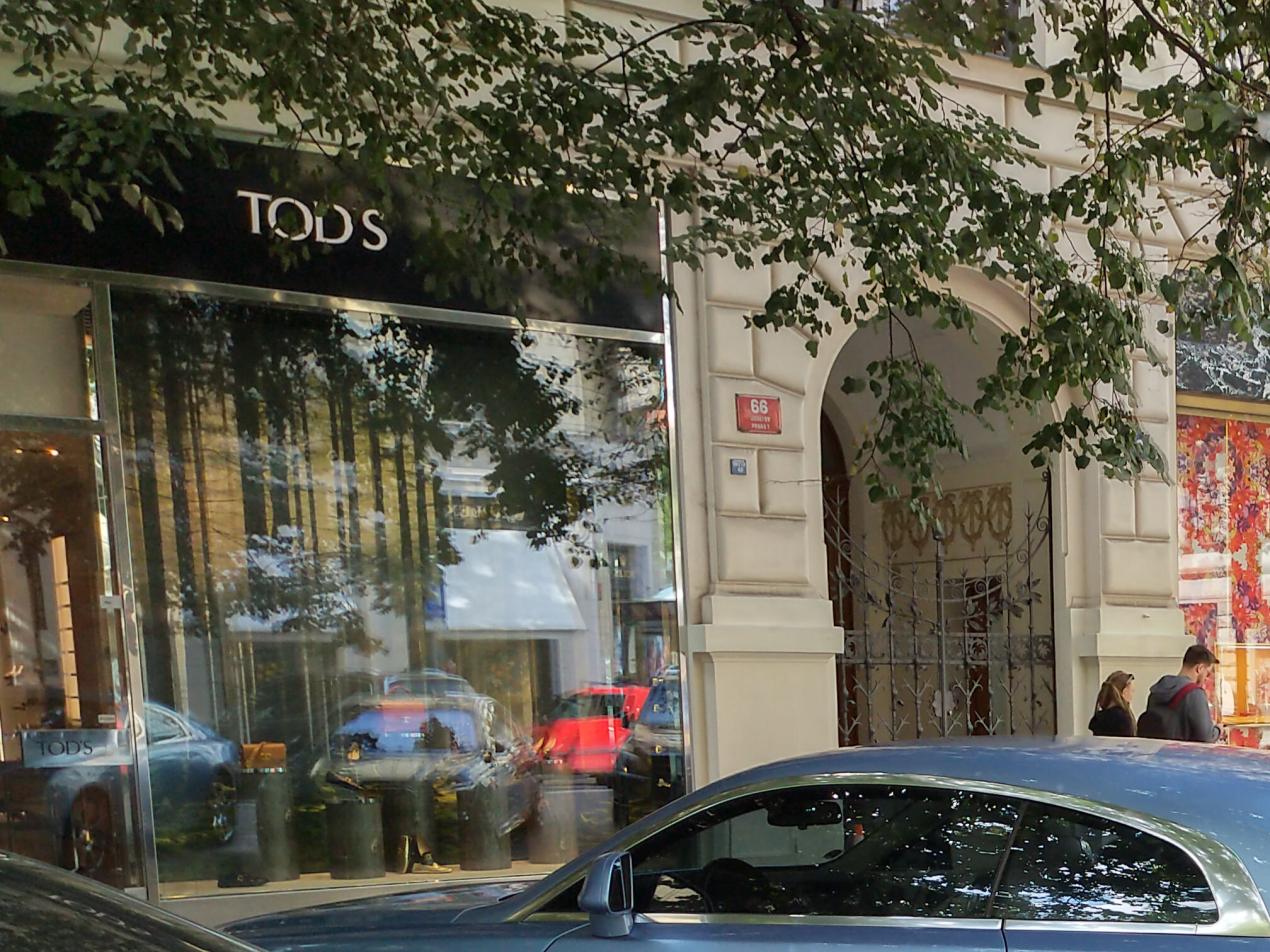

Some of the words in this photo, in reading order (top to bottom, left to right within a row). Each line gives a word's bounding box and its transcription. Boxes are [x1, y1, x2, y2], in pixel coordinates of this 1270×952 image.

[236, 189, 388, 251] TODS
[751, 399, 768, 414] 66
[36, 740, 93, 756] TOD'S
